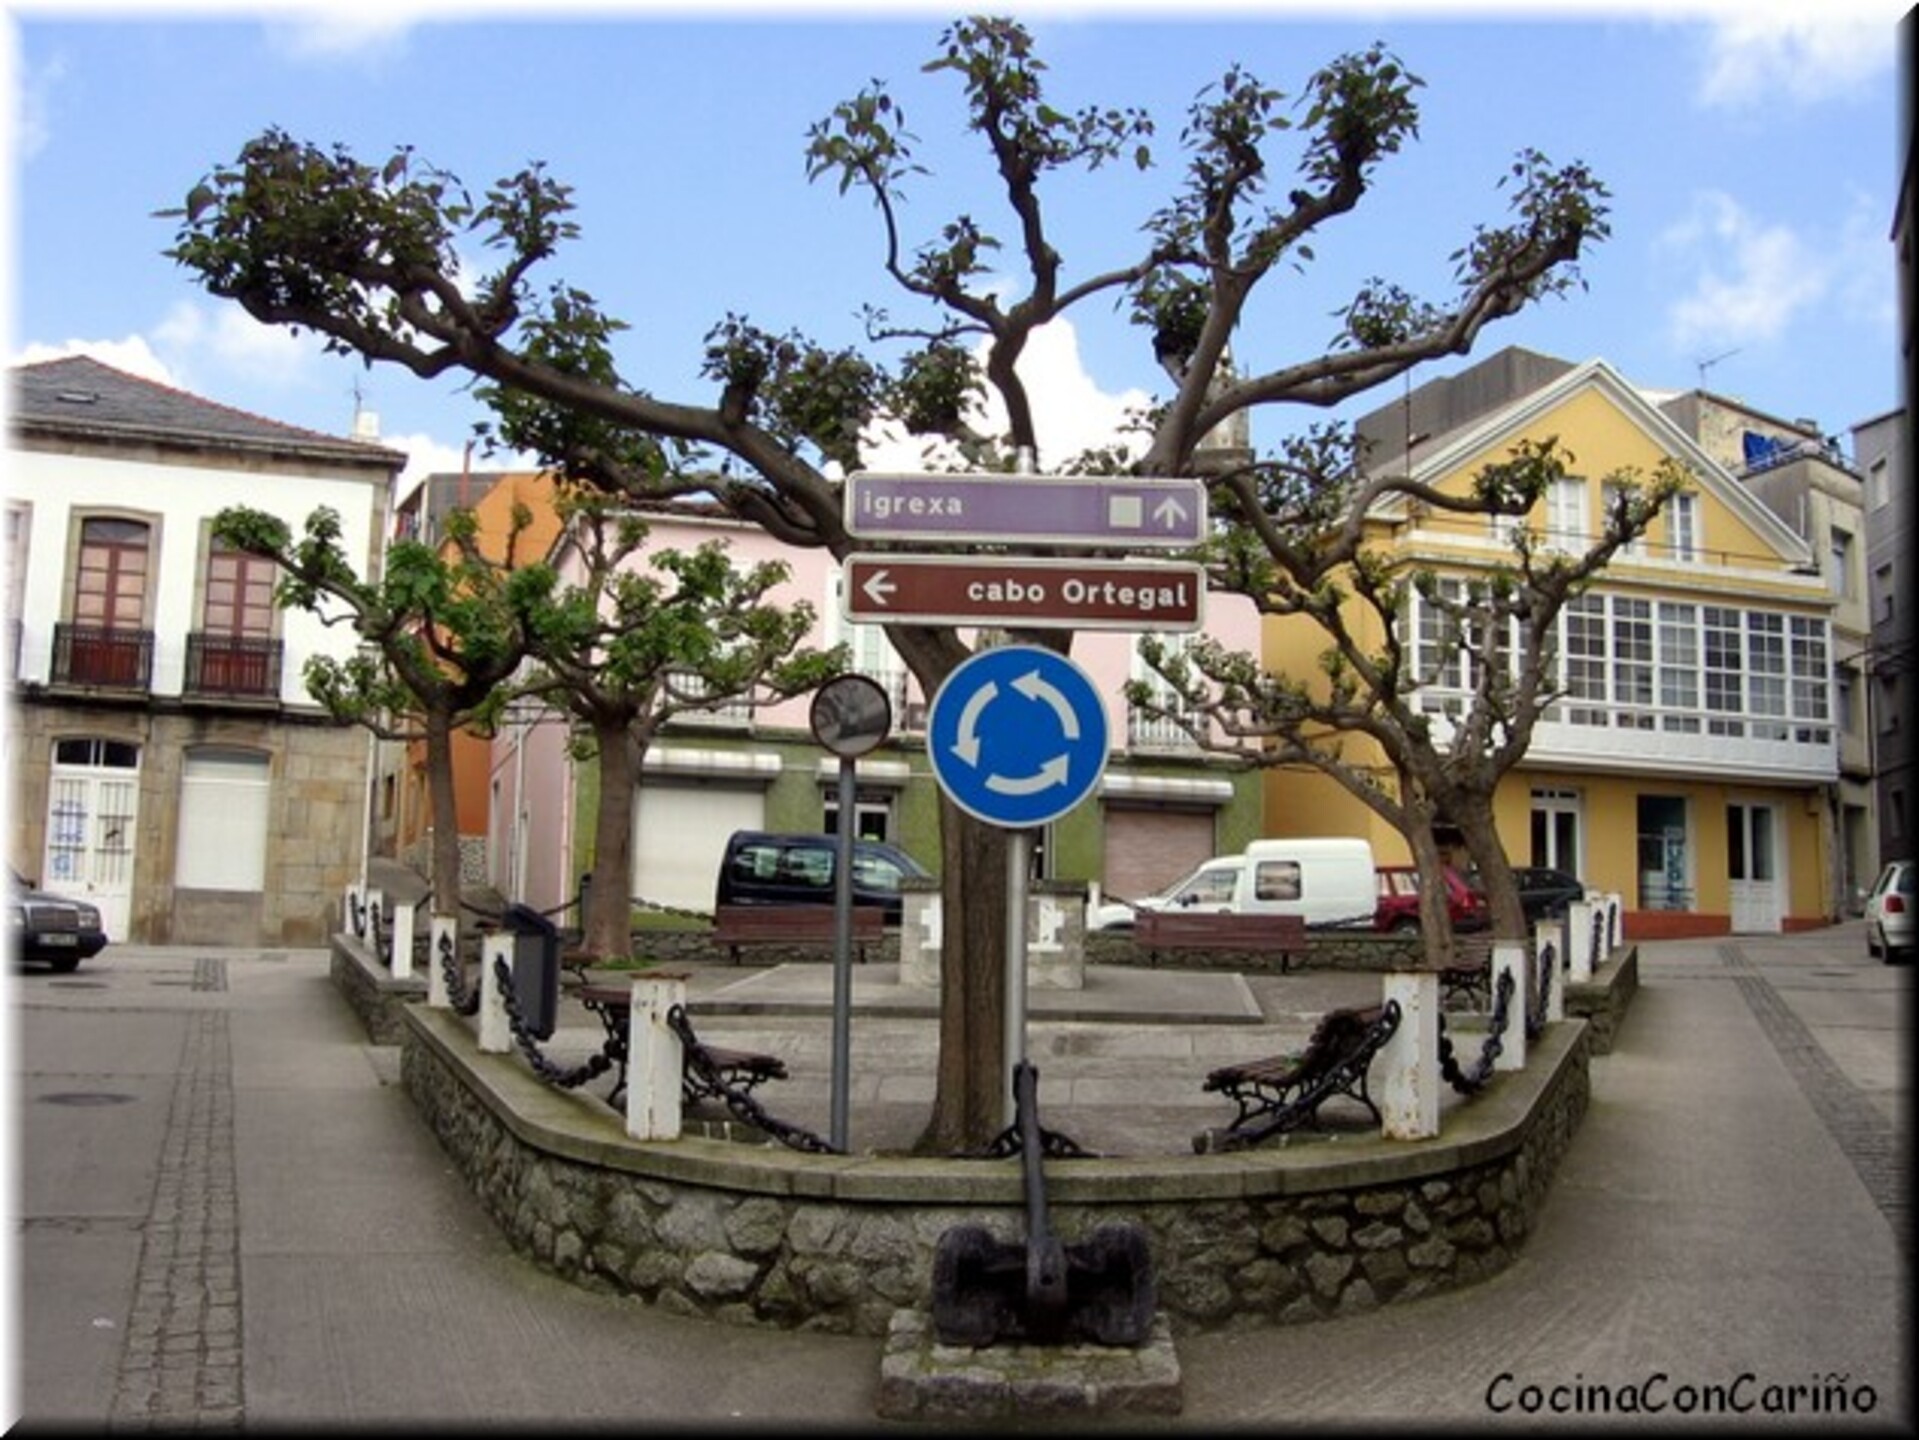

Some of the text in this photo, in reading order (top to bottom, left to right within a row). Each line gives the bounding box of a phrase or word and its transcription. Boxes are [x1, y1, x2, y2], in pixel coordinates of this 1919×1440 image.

[862, 490, 963, 518] igrexa
[967, 578, 1188, 609] cabo Ortegal
